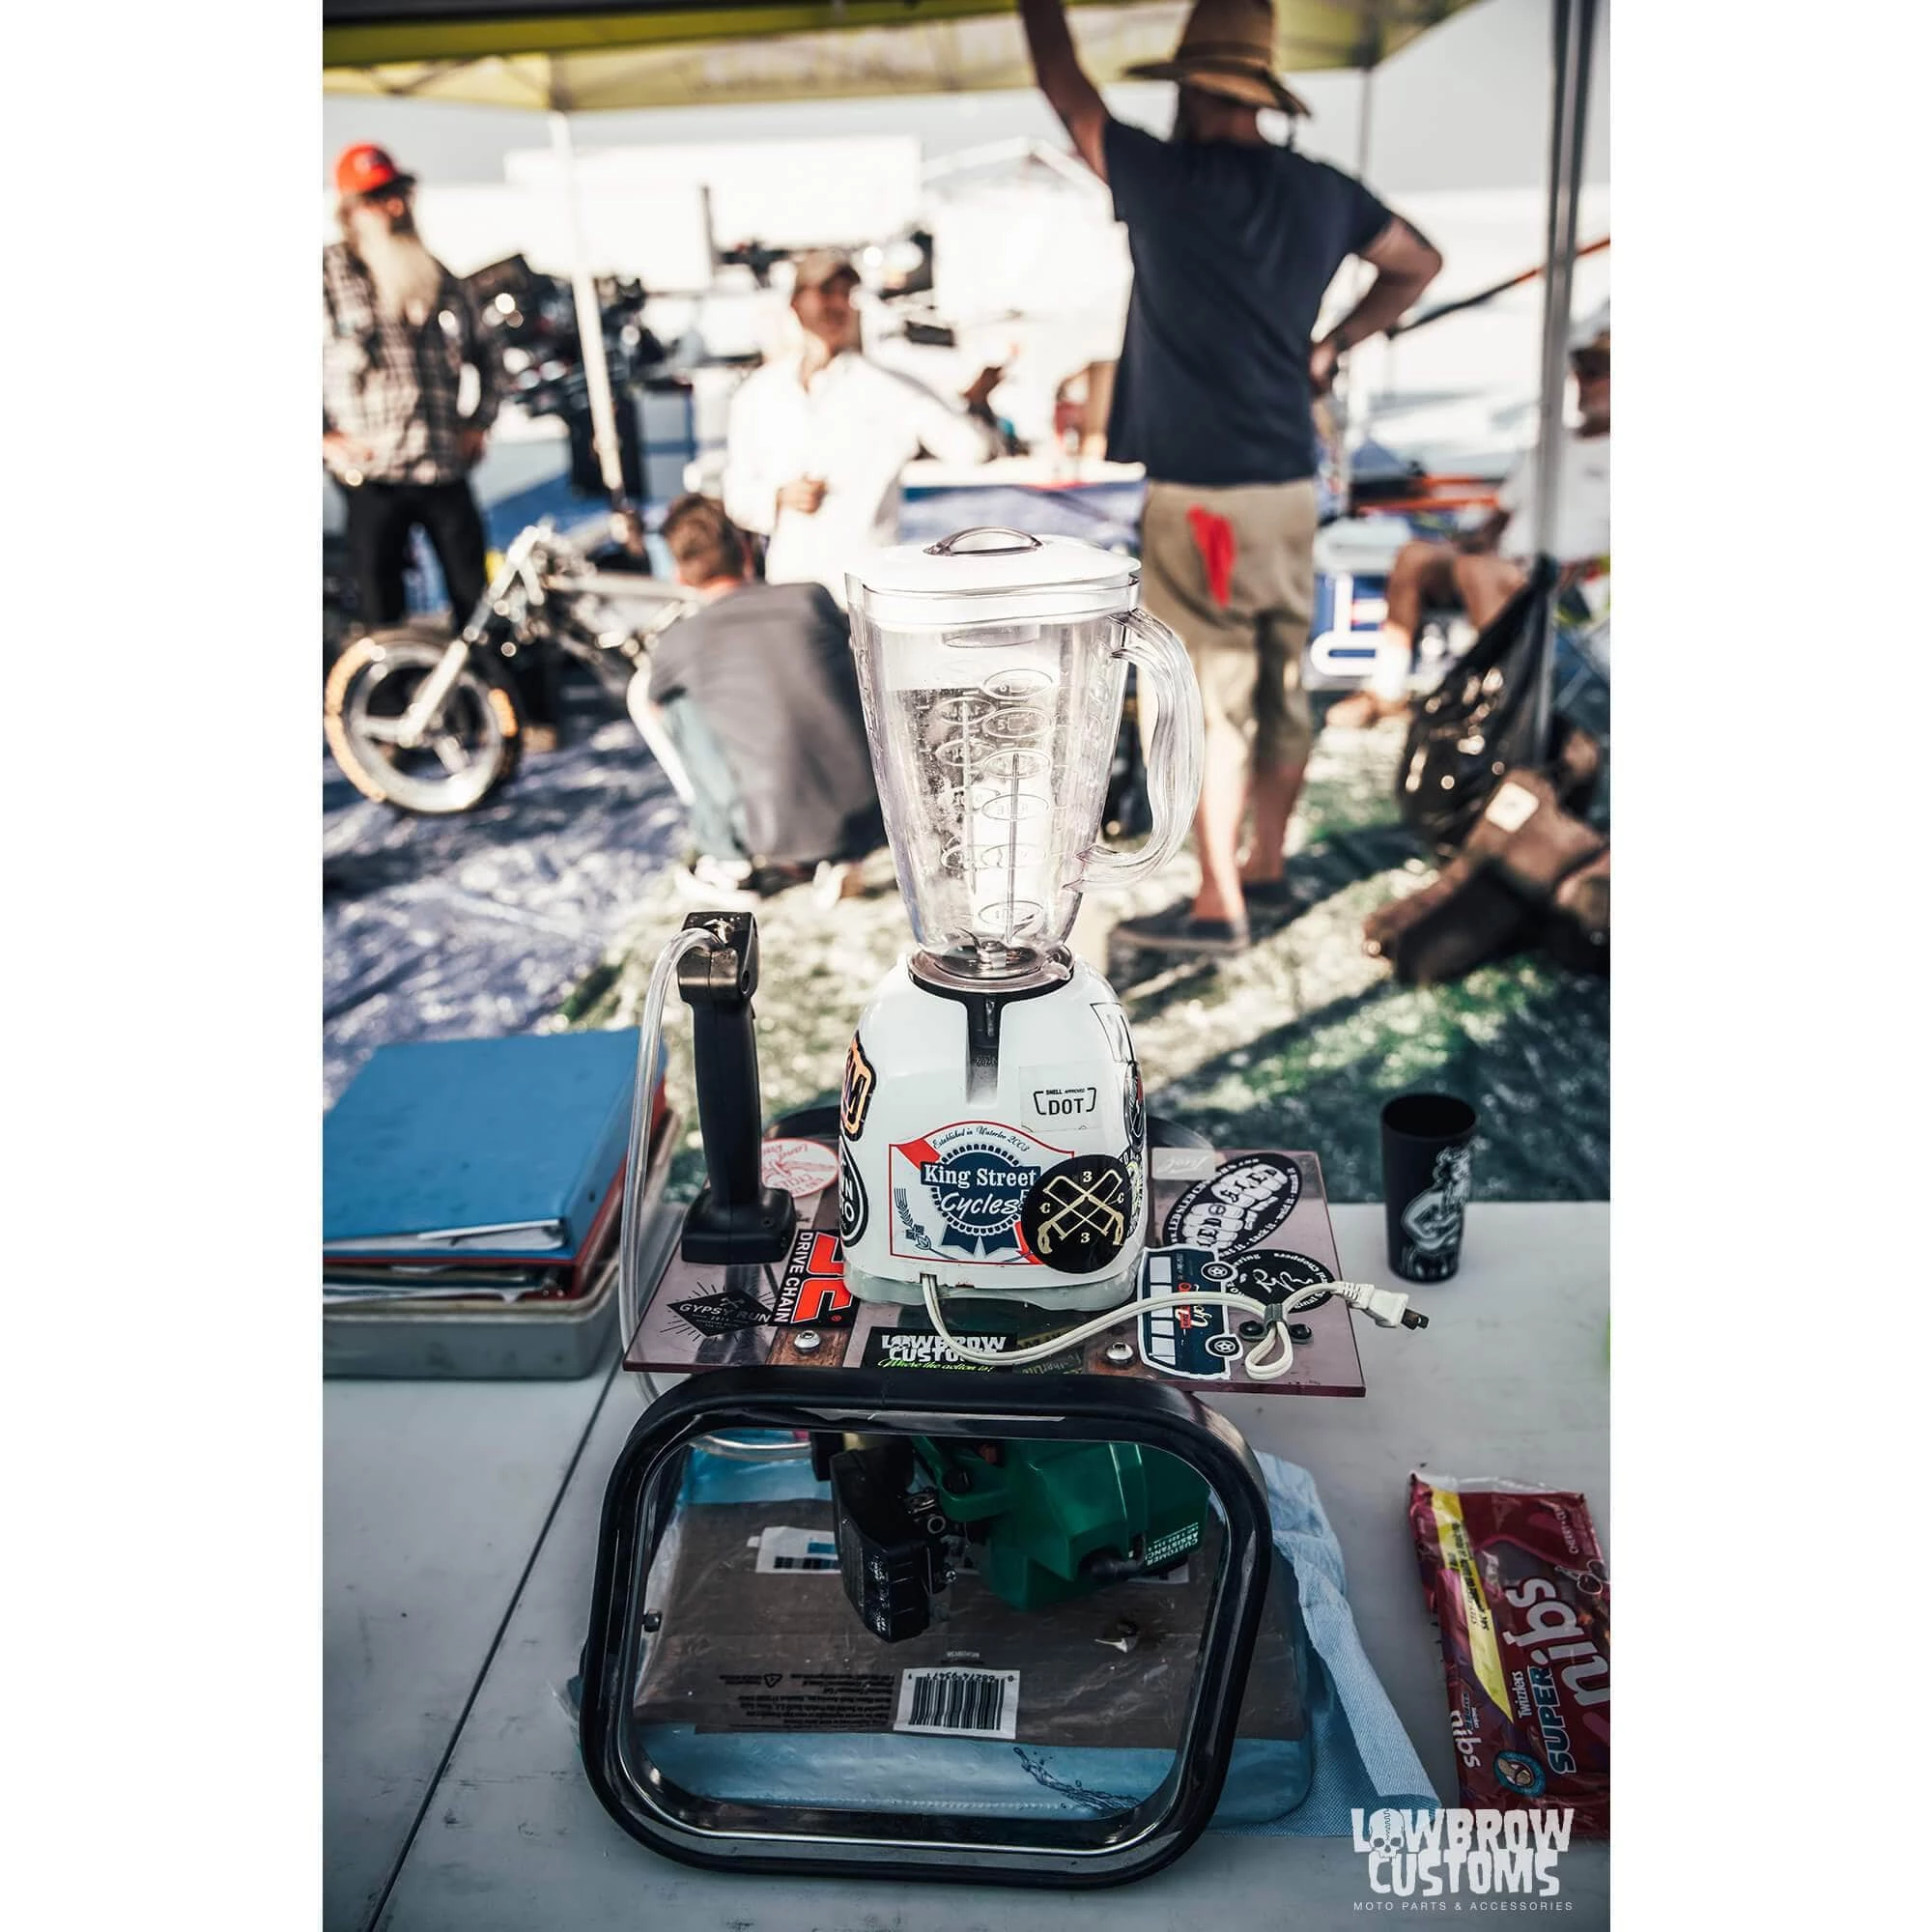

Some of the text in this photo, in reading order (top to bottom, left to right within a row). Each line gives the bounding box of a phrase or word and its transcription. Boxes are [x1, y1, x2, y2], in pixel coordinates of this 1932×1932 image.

[1048, 1098, 1084, 1116] DOT
[932, 1128, 965, 1150] Established
[976, 1125, 1007, 1140] Waterloo
[1008, 1135, 1030, 1152] 2003
[924, 1164, 1037, 1189] King Street
[1082, 1170, 1094, 1183] 3
[941, 1192, 1020, 1220] Cycles
[1080, 1232, 1091, 1243] 3
[773, 1232, 814, 1323] DRIVE CHAIN
[736, 1310, 772, 1323] RUN
[877, 1358, 923, 1369] Where
[923, 1360, 942, 1370] the
[941, 1363, 976, 1372] action
[1147, 1538, 1199, 1566] CUSTOMER
[1500, 1577, 1610, 1707] nibs
[1512, 1670, 1532, 1719] Twizzlers
[1527, 1665, 1577, 1774] SUPER
[1450, 1710, 1482, 1768] nibs
